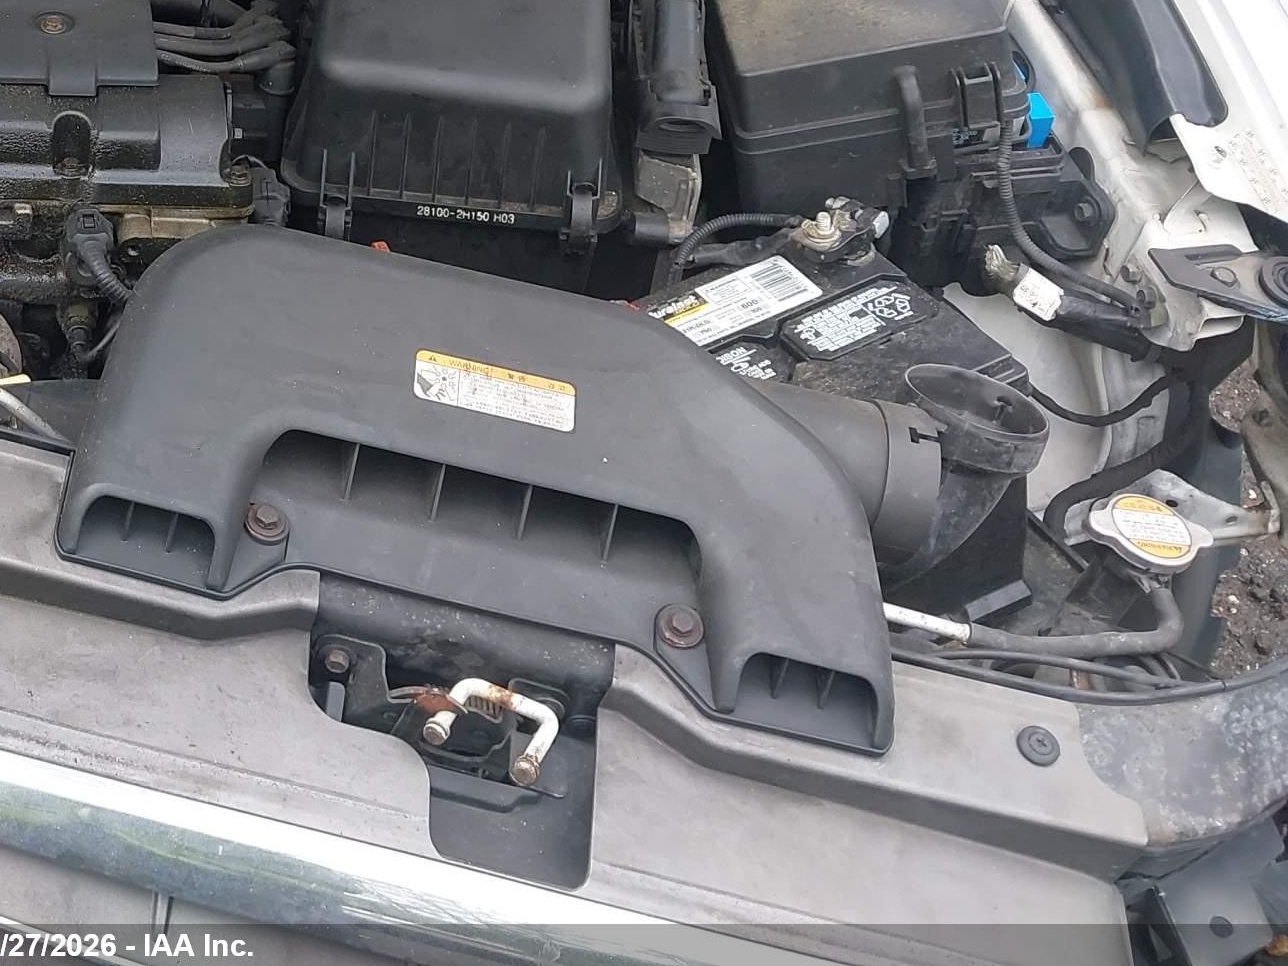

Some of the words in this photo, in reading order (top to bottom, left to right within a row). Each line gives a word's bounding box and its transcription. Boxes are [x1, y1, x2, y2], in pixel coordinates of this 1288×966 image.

[416, 205, 490, 222] 28100-2H150
[492, 213, 516, 225] H03
[649, 294, 700, 318] uralast
[740, 298, 759, 309] 600
[716, 346, 747, 364] ISON
